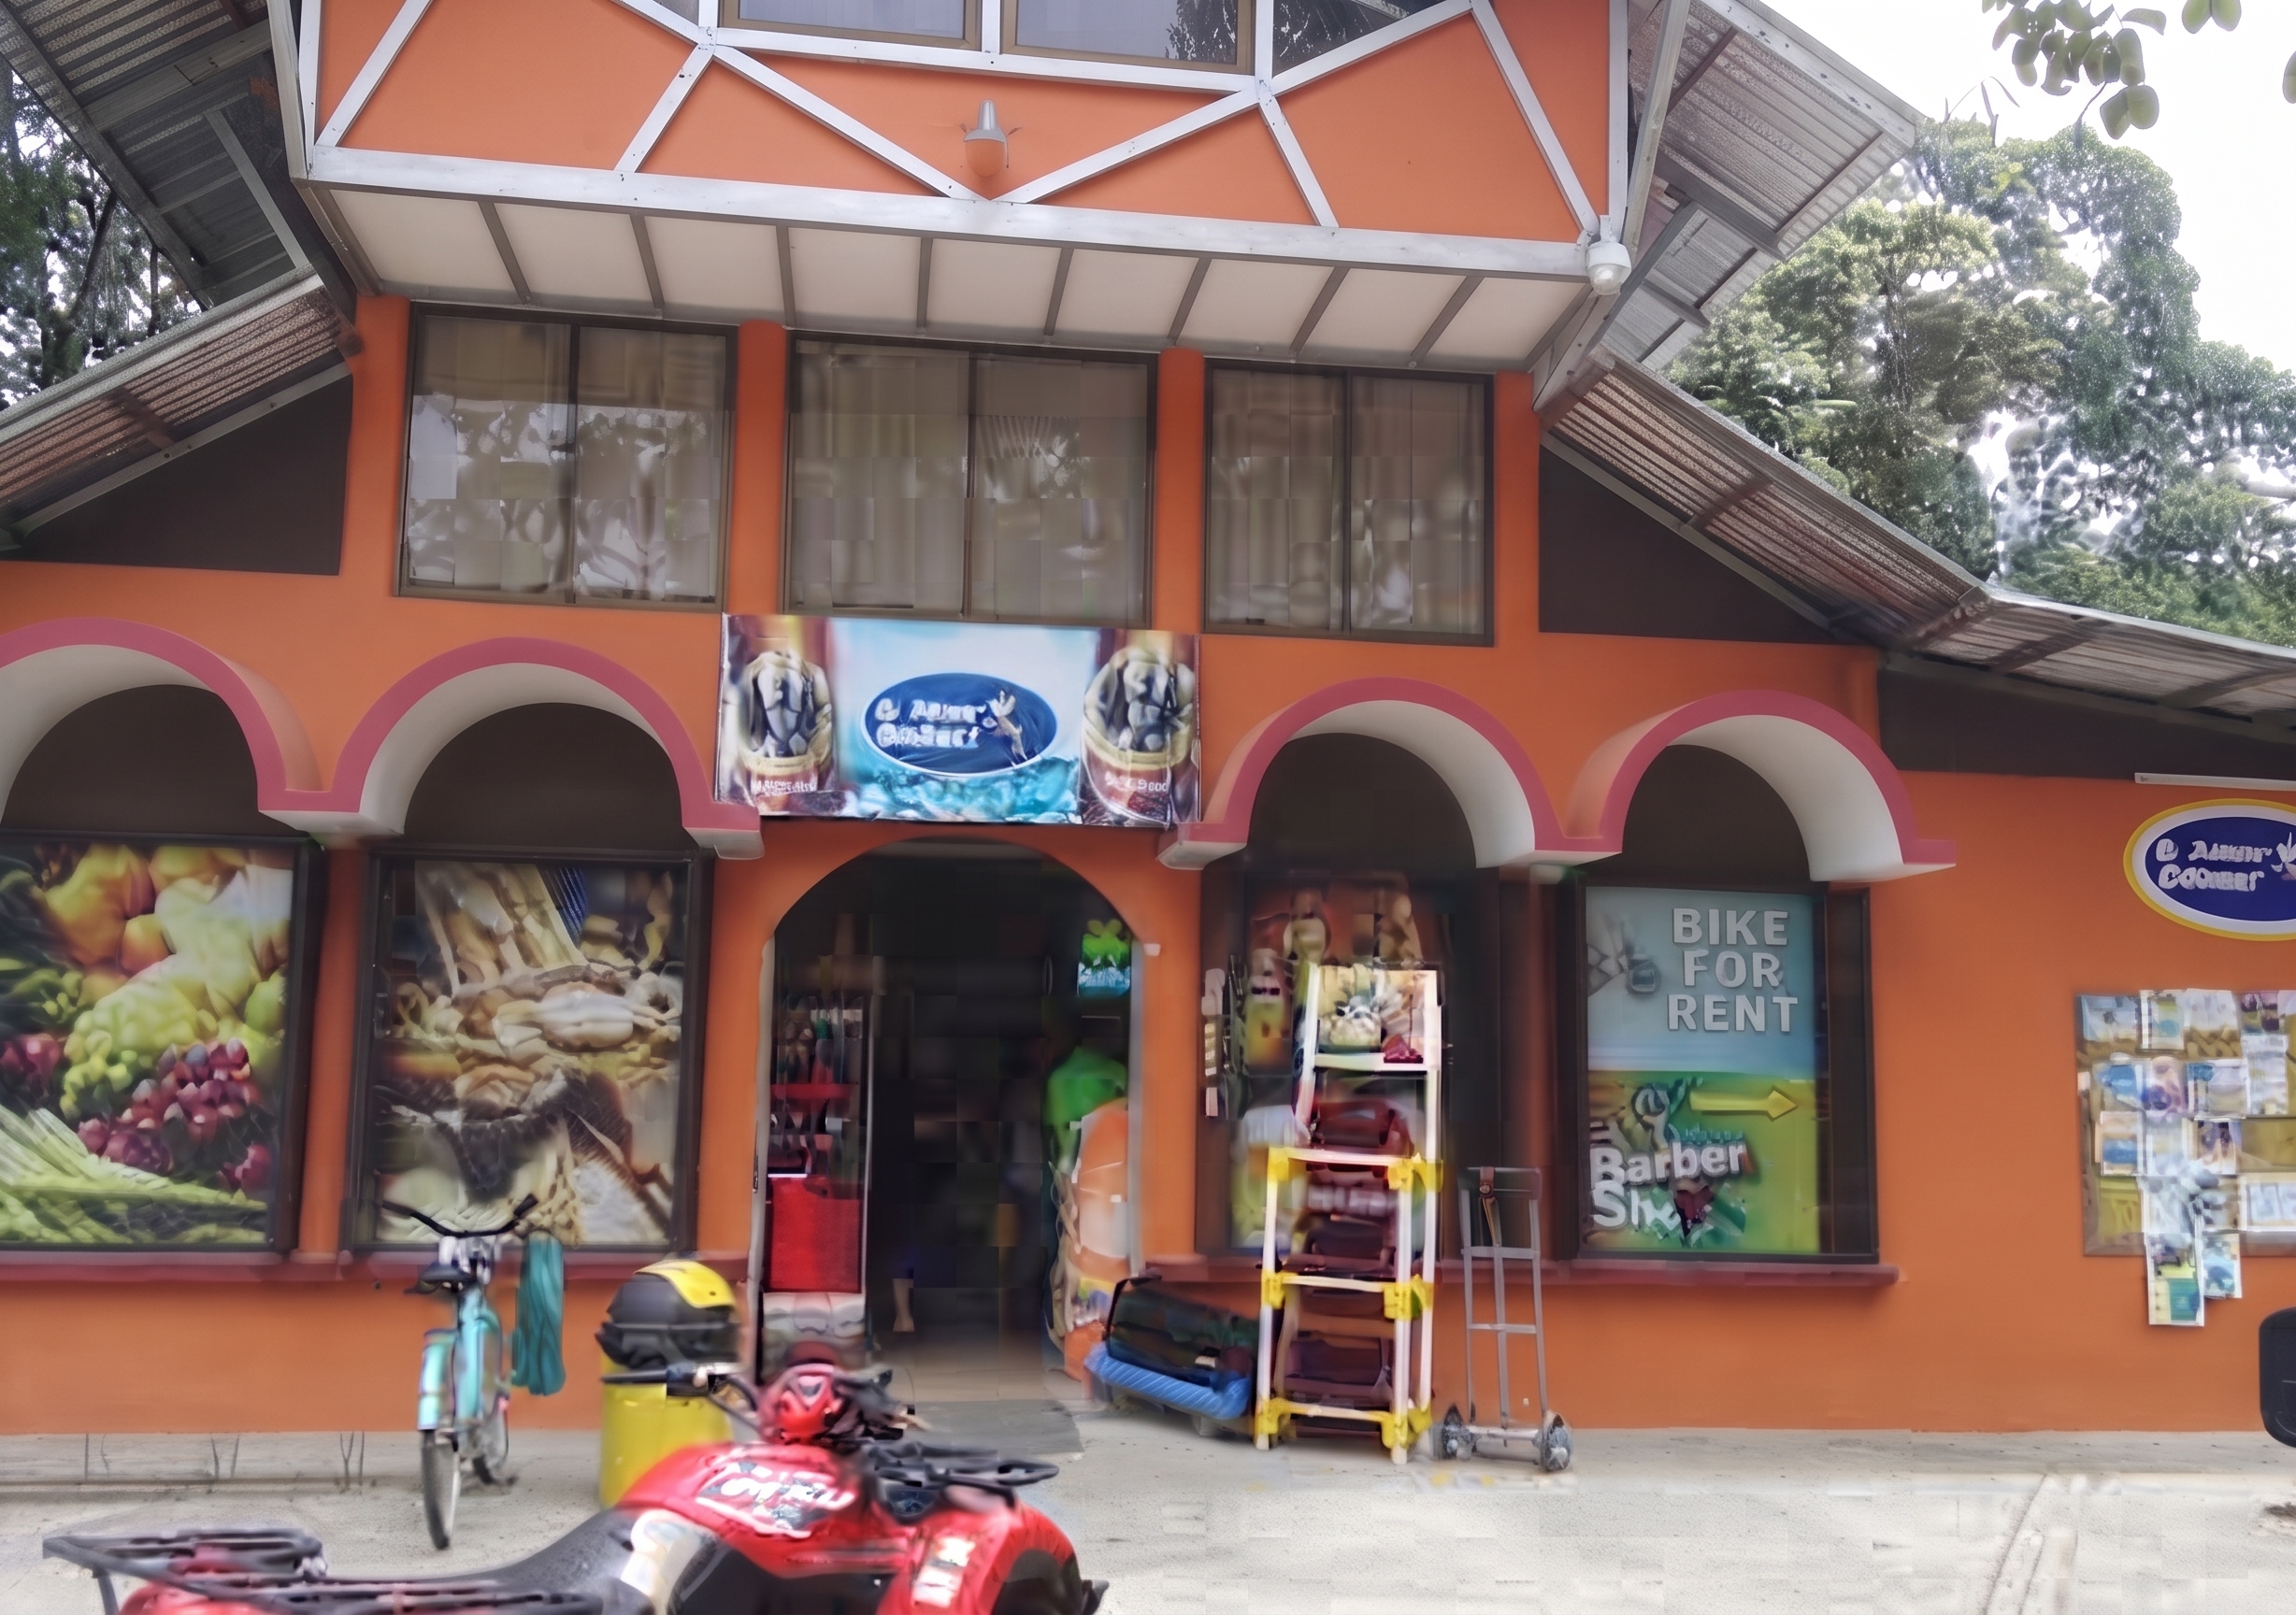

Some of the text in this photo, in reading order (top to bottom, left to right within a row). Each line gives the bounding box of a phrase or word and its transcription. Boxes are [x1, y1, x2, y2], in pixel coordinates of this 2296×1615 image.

[1672, 907, 1788, 946] BIKE
[1683, 949, 1782, 988] FOR
[1668, 993, 1799, 1033] RENT
[1590, 1141, 1746, 1186] Barber
